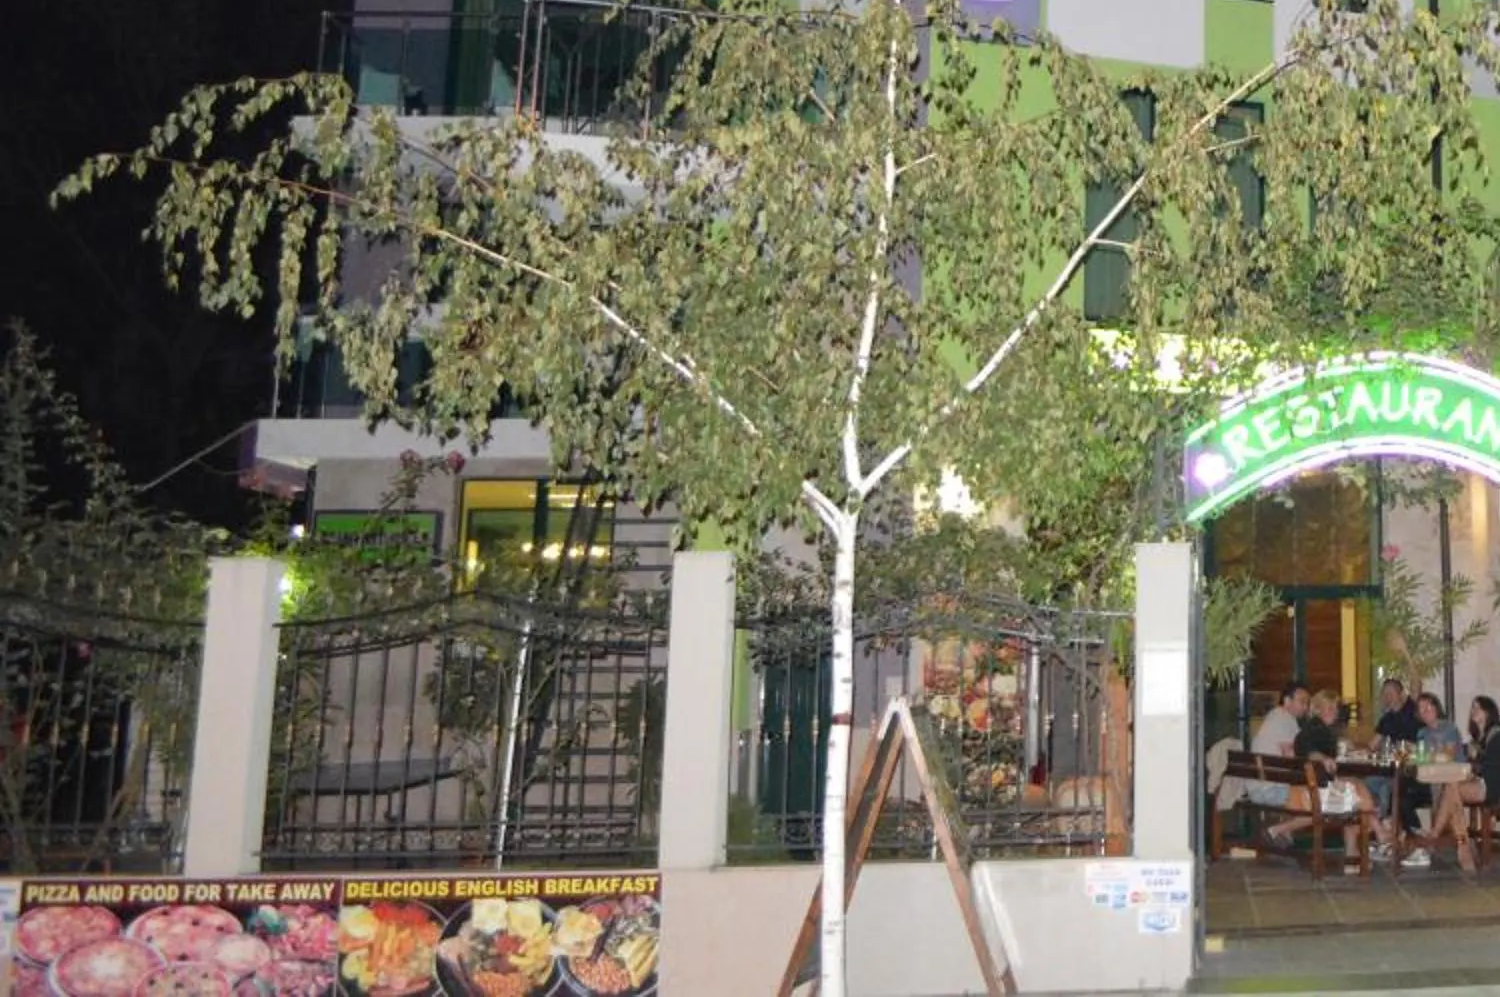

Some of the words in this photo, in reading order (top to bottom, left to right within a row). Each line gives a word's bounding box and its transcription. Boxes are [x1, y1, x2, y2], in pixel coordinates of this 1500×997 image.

[26, 884, 80, 902] PIZZA
[85, 884, 124, 901] AND
[128, 884, 179, 901] FOOD
[183, 884, 221, 901] FOR
[227, 883, 276, 900] TAKE
[280, 882, 336, 900] AWAY
[347, 880, 449, 898] DELICIOUS
[455, 878, 539, 896] ENGLISH
[545, 876, 660, 894] BREAKFAST
